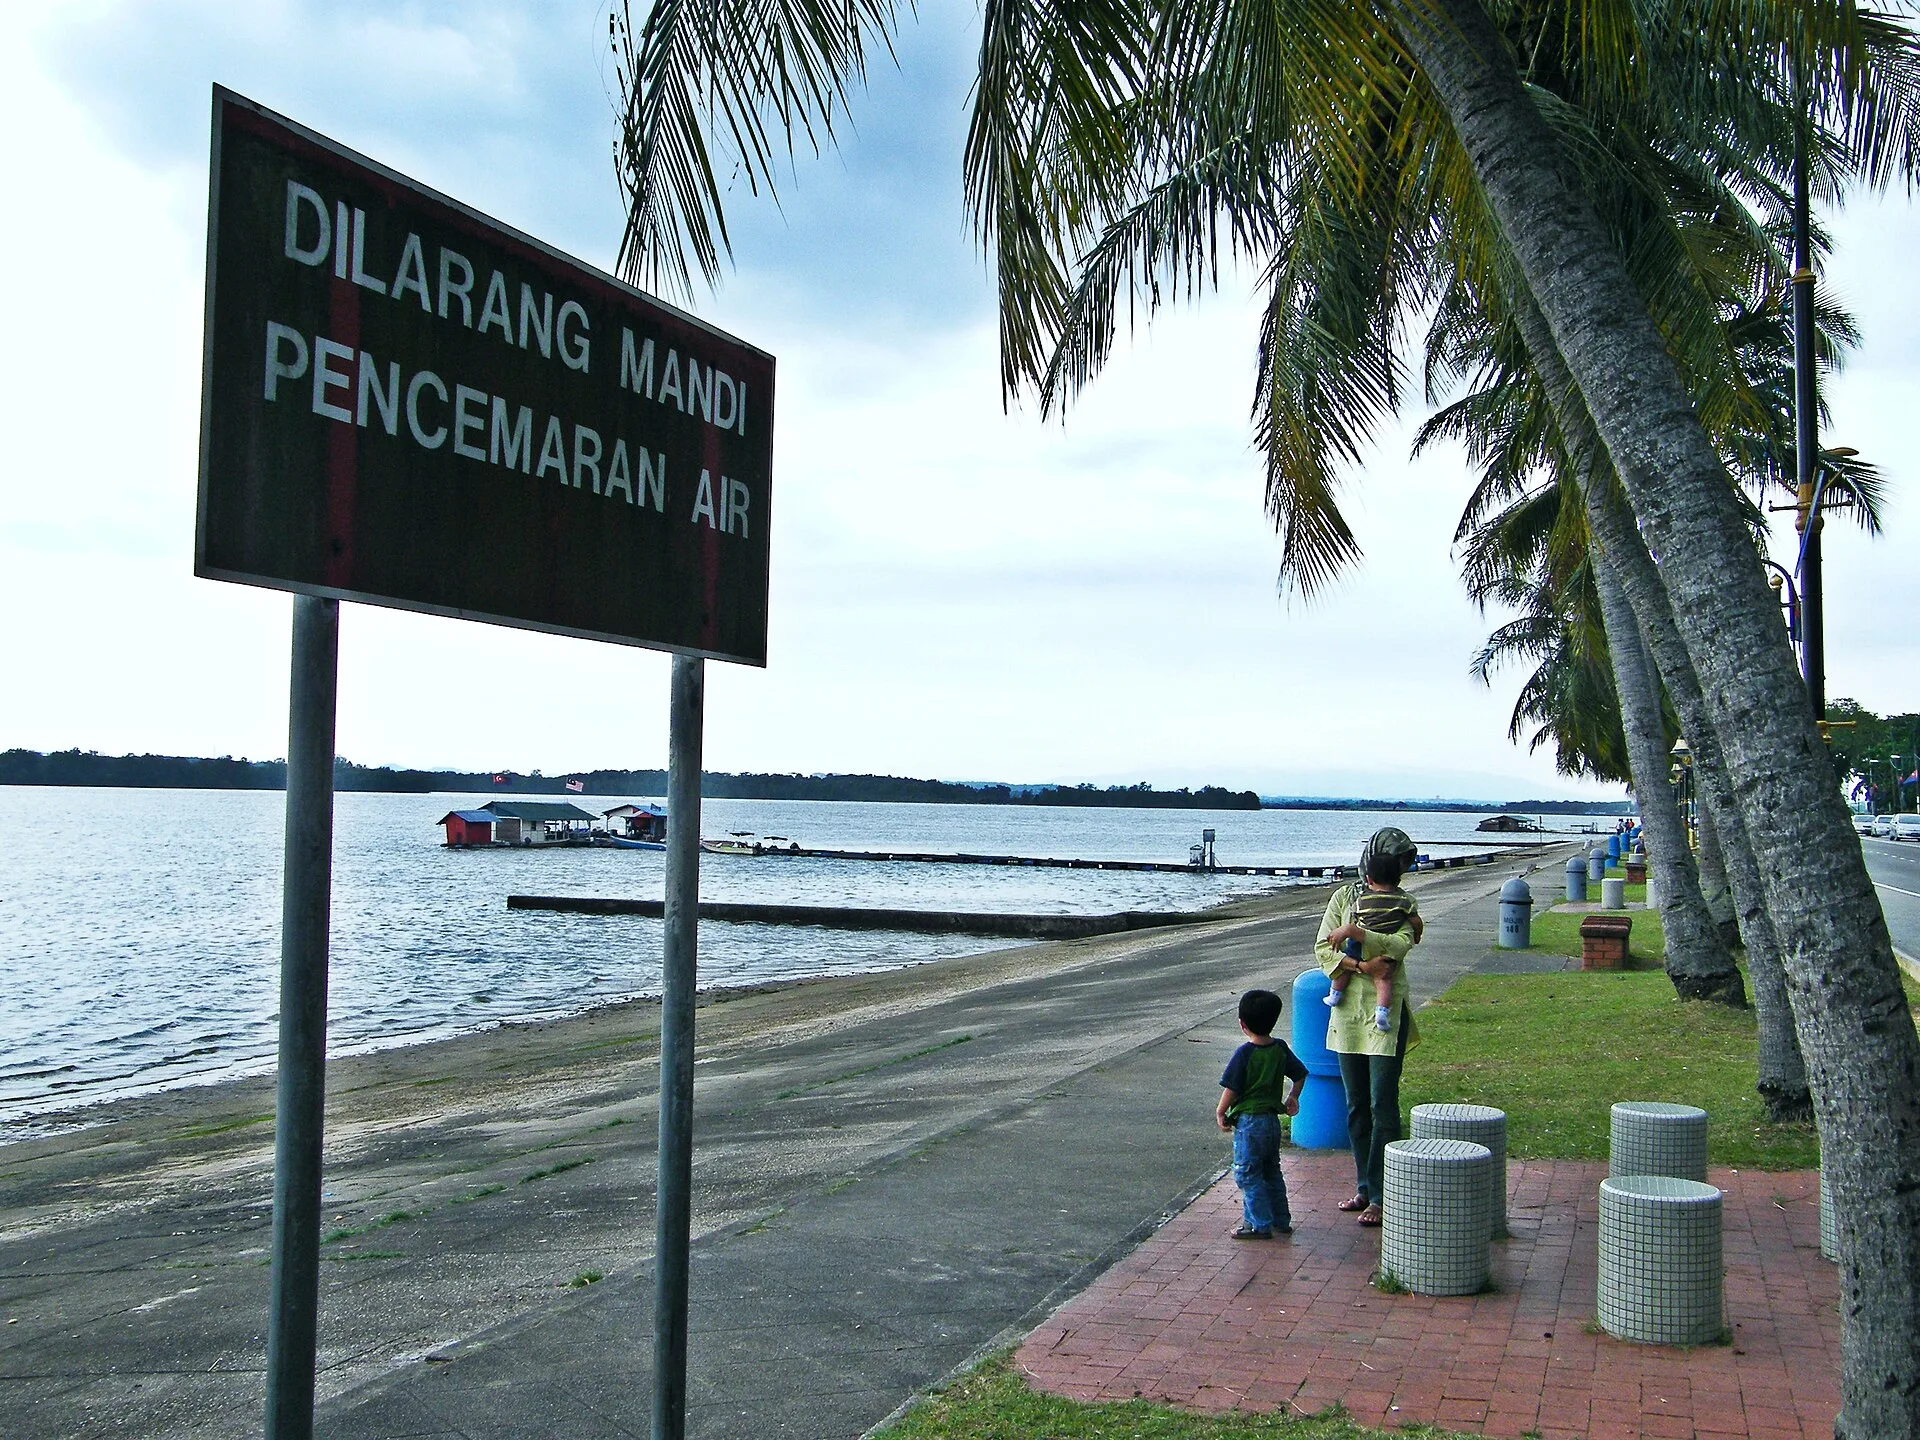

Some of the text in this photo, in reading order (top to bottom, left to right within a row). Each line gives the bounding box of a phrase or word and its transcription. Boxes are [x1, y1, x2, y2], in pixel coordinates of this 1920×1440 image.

[285, 180, 747, 437] DILARANG MANDI
[263, 320, 750, 539] PENCEMARAN AIR
